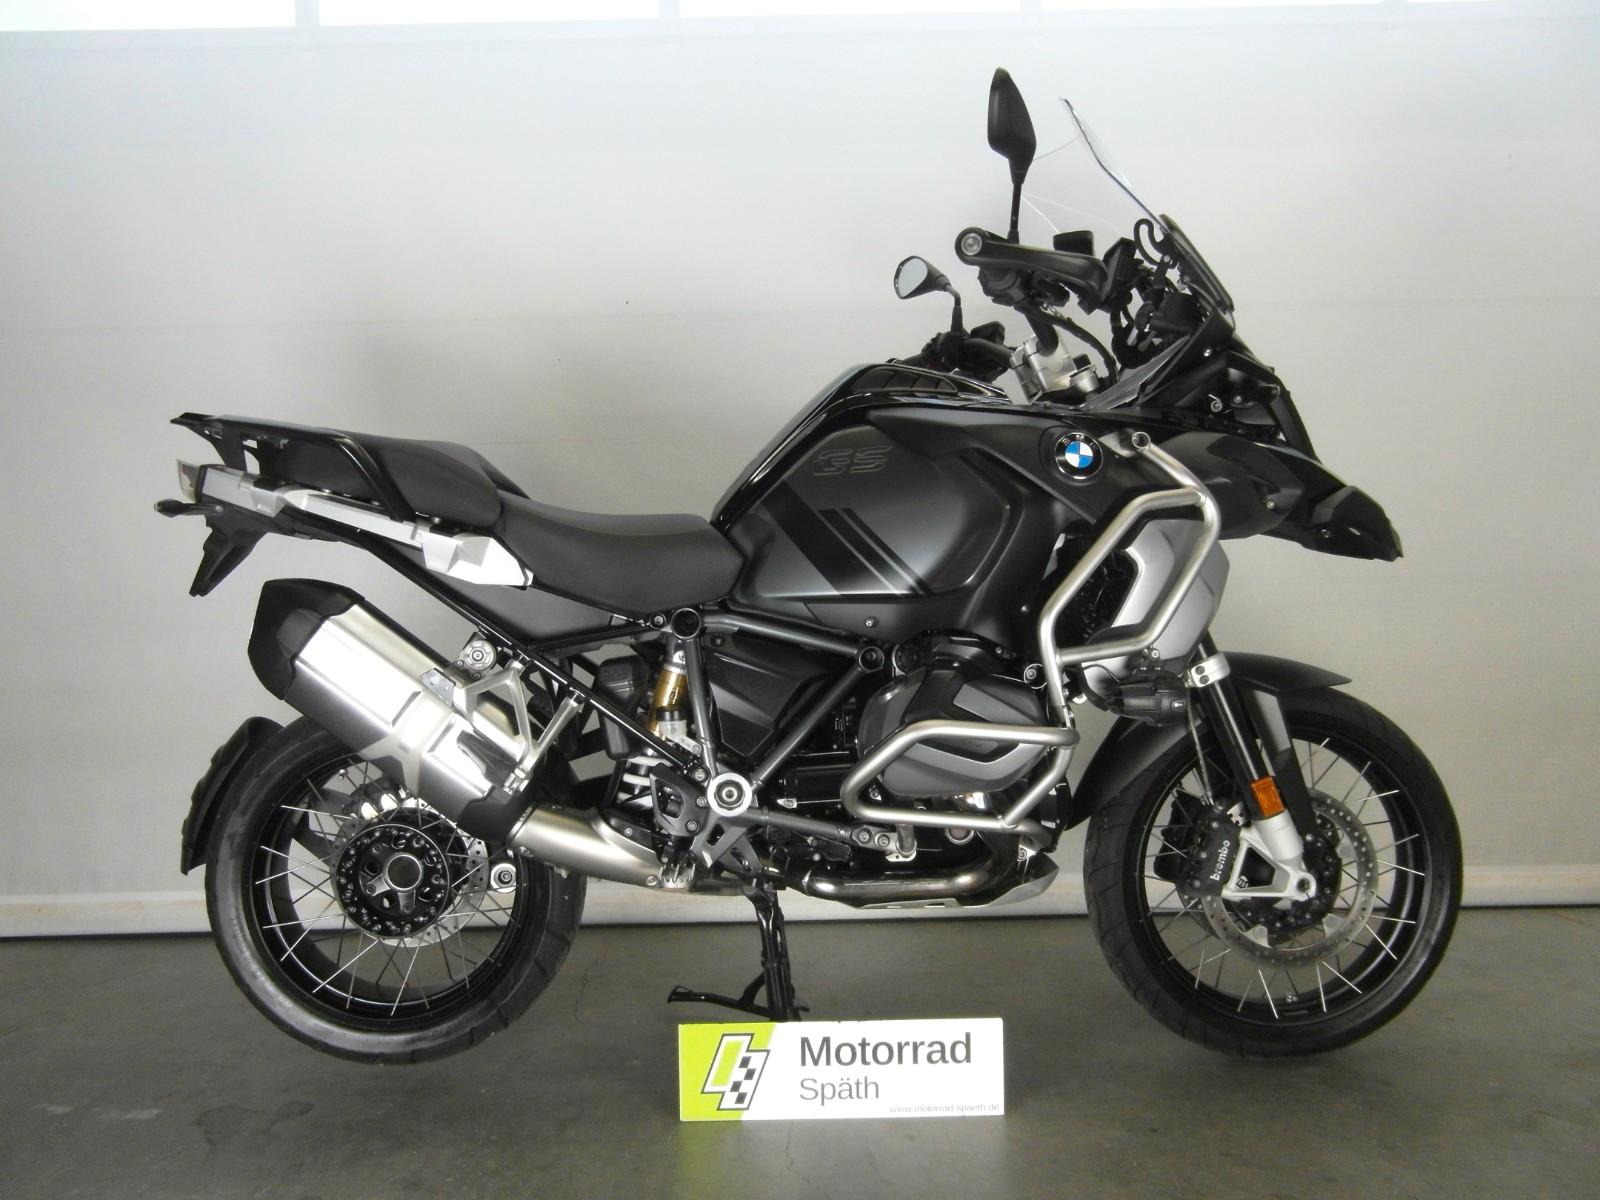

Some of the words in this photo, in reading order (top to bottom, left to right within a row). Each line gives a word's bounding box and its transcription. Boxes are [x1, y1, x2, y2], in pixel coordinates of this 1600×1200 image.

[1210, 840, 1230, 880] brembo
[800, 1032, 972, 1067] Motorrad
[799, 1076, 880, 1106] Späth
